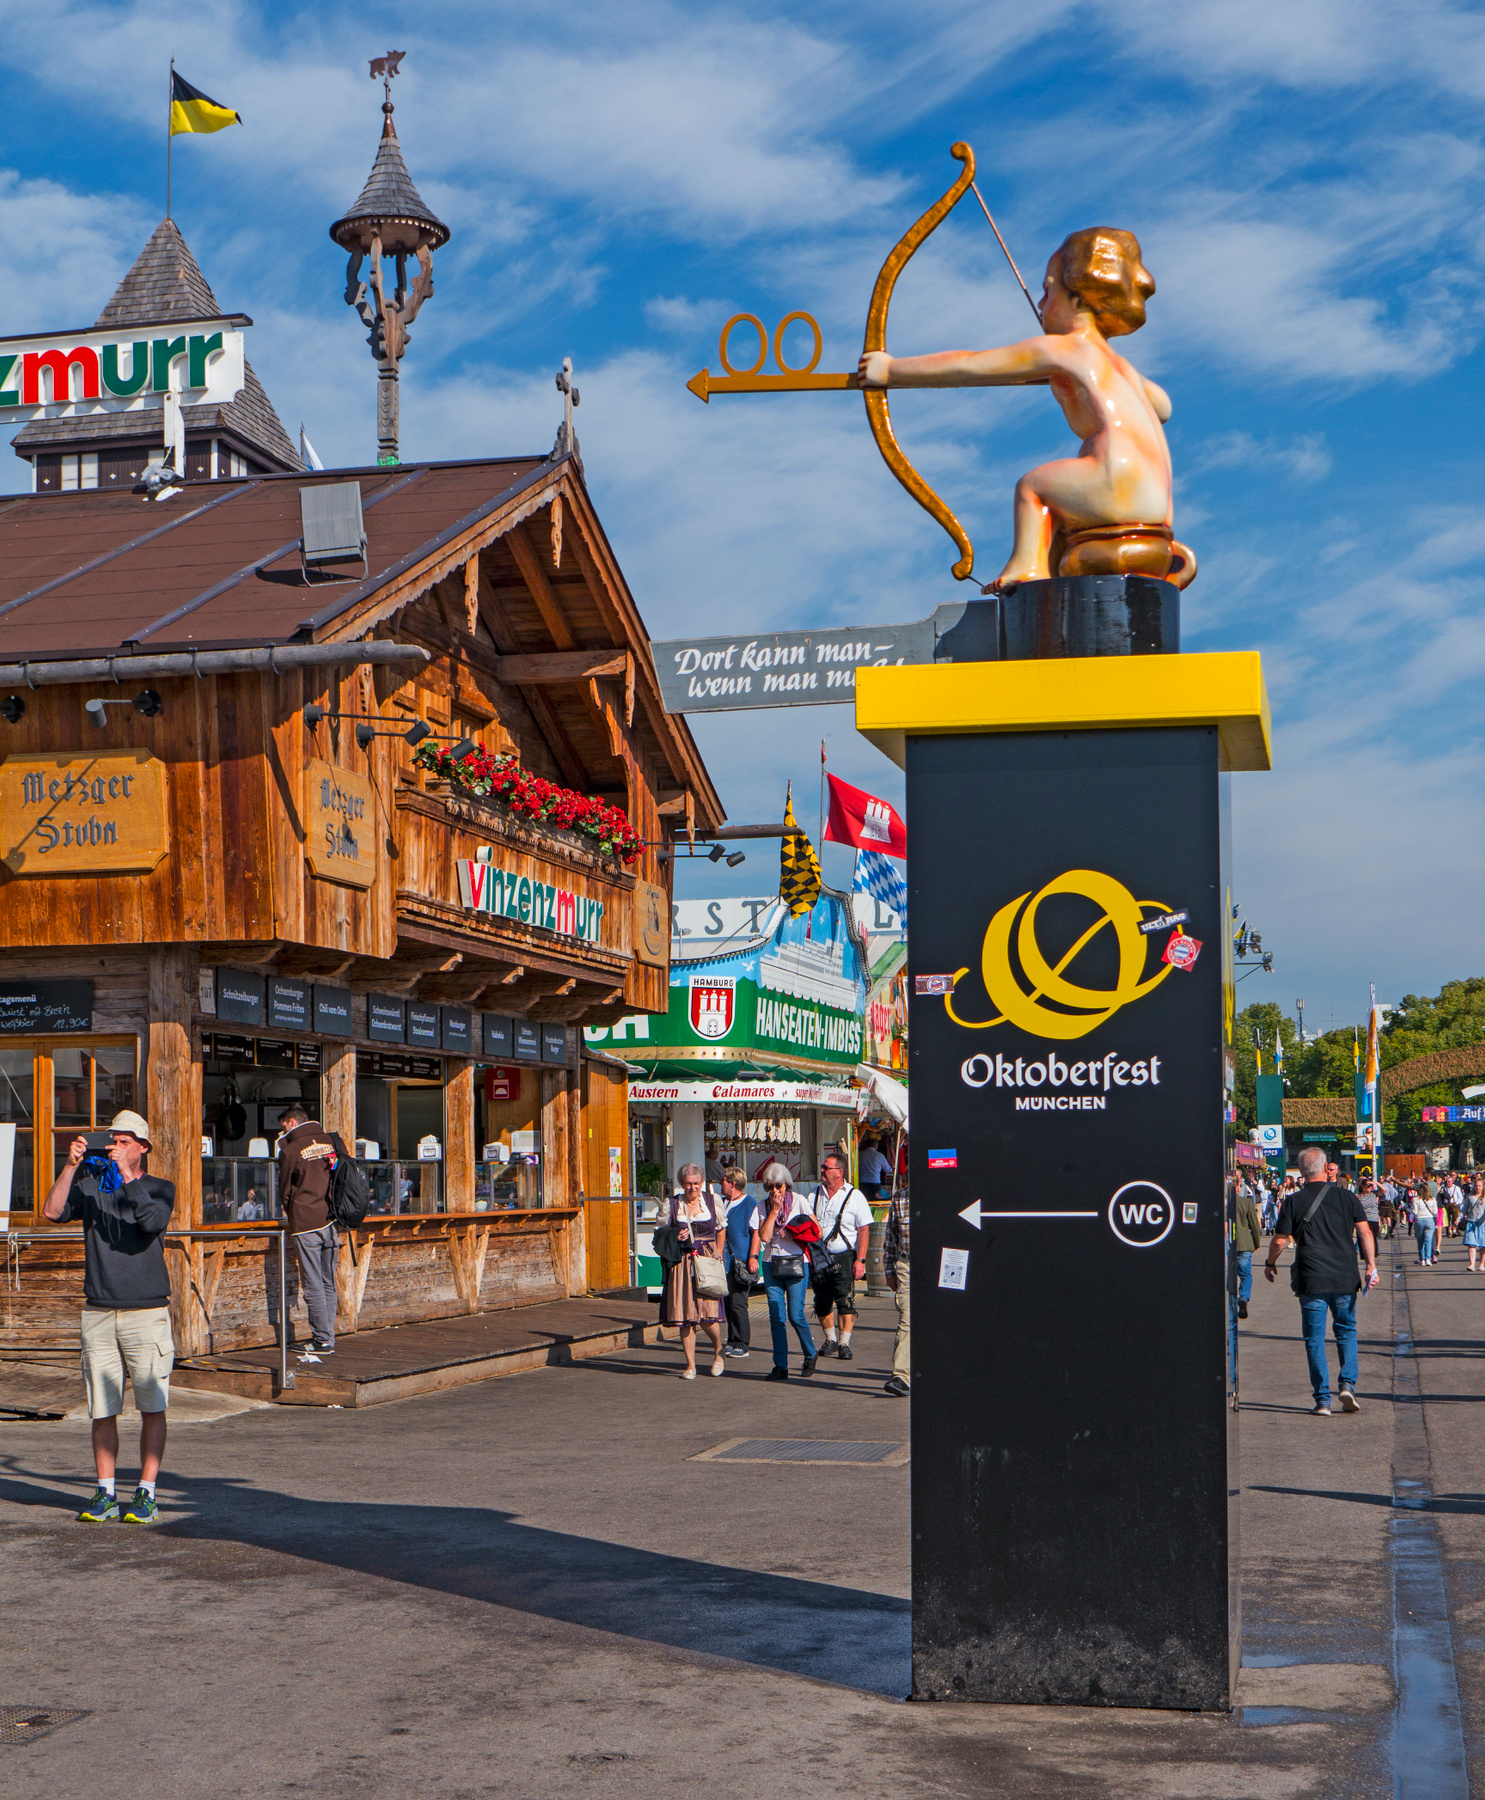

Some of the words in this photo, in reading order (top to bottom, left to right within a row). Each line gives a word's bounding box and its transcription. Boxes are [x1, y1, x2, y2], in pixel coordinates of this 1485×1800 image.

[674, 644, 739, 675] Dort
[740, 641, 806, 671] kann
[688, 676, 752, 698] wenn
[763, 673, 818, 692] man
[21, 770, 135, 809] Metzger
[320, 778, 365, 821] Metzger
[693, 978, 734, 987] HAMBURG
[755, 996, 861, 1055] HANSEATEN-IMBISS
[961, 1051, 1162, 1092] Oktoberfest
[629, 1085, 679, 1098] Austern
[712, 1085, 776, 1098] Calamares
[1015, 1096, 1106, 1111] MÜNCHEN
[1119, 1204, 1164, 1225] WC
